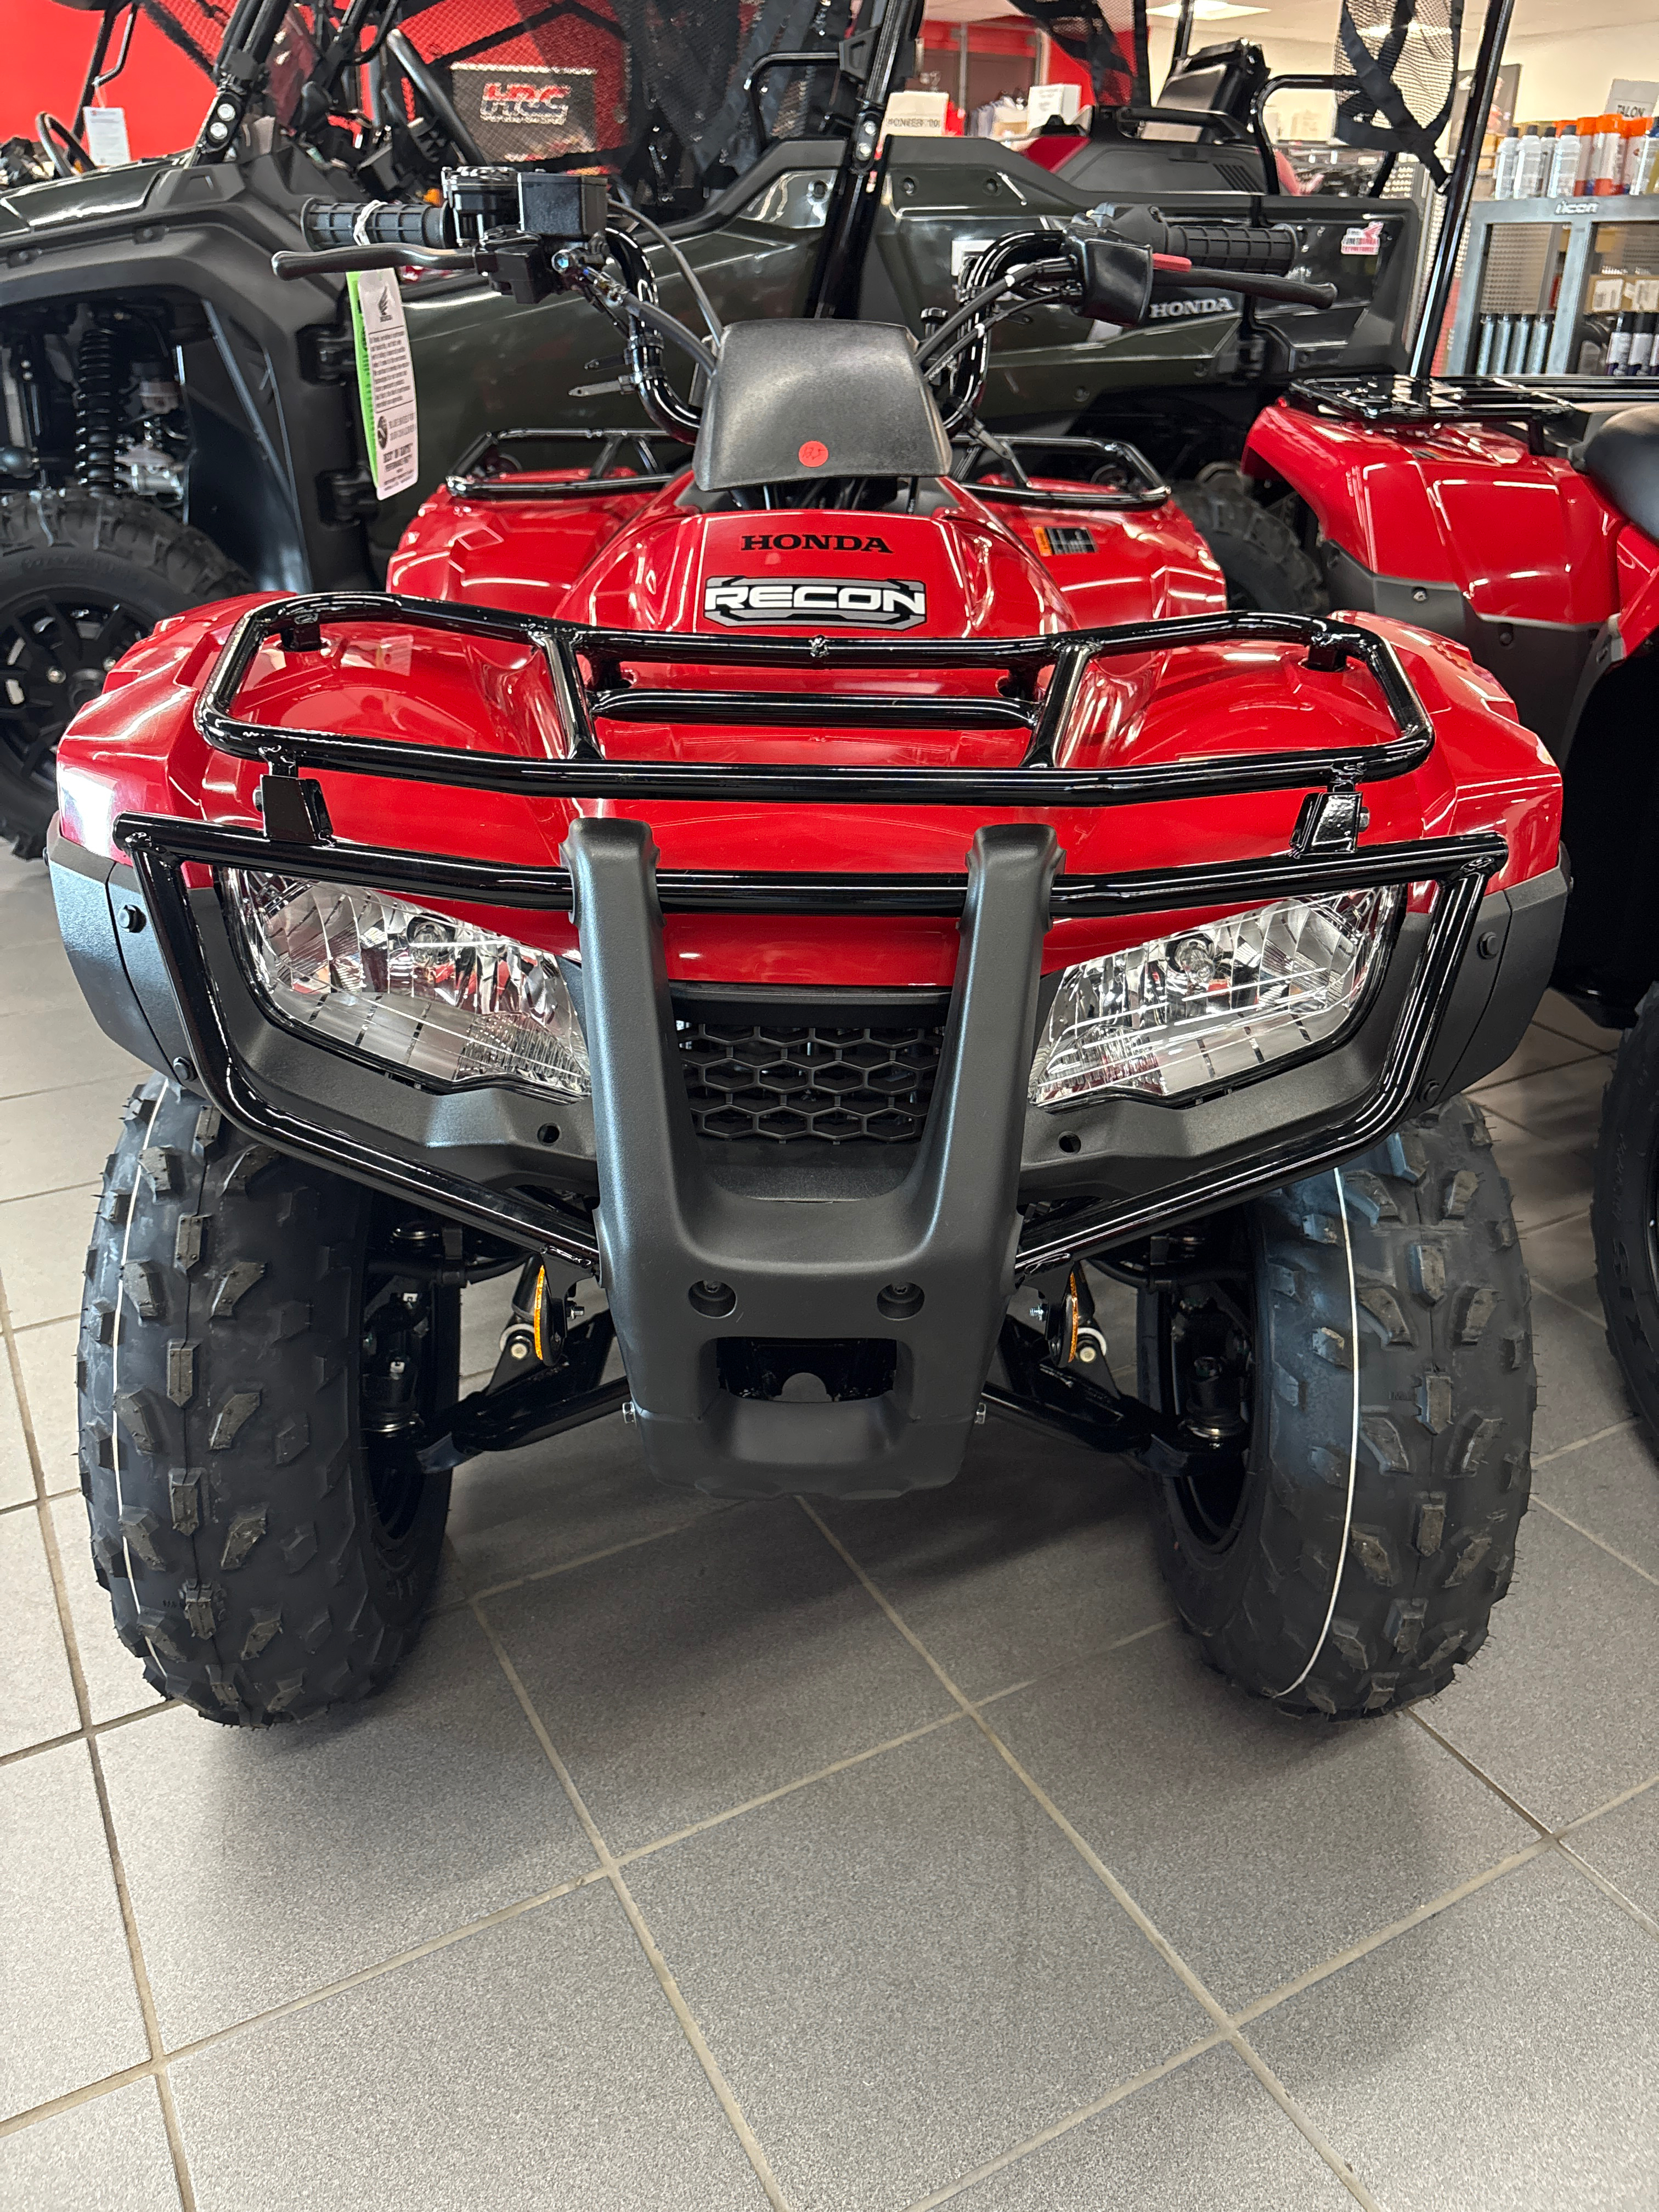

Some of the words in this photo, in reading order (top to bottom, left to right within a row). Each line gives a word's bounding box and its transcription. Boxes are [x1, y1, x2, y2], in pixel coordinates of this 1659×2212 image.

[480, 83, 571, 116] HRC
[1149, 297, 1235, 319] HONDA
[741, 534, 894, 554] HONDA
[704, 585, 927, 615] RECON
